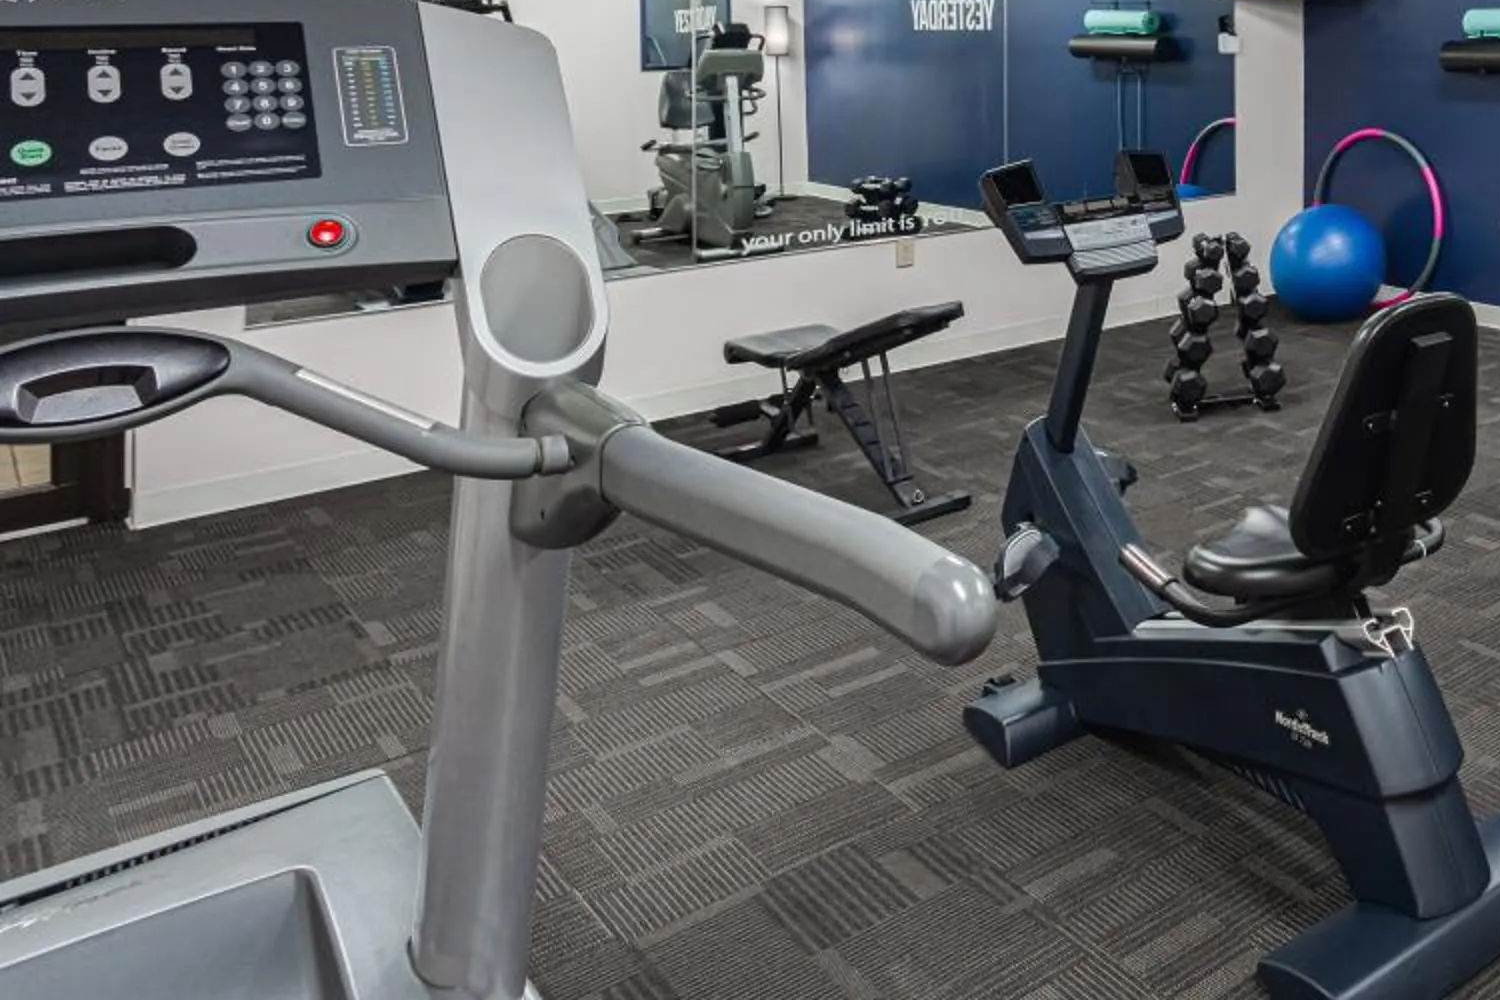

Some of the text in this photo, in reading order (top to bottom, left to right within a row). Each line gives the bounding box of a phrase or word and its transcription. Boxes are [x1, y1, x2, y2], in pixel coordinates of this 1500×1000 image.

[741, 231, 794, 256] your
[798, 223, 845, 243] only
[850, 217, 895, 237] limit
[898, 213, 916, 232] is
